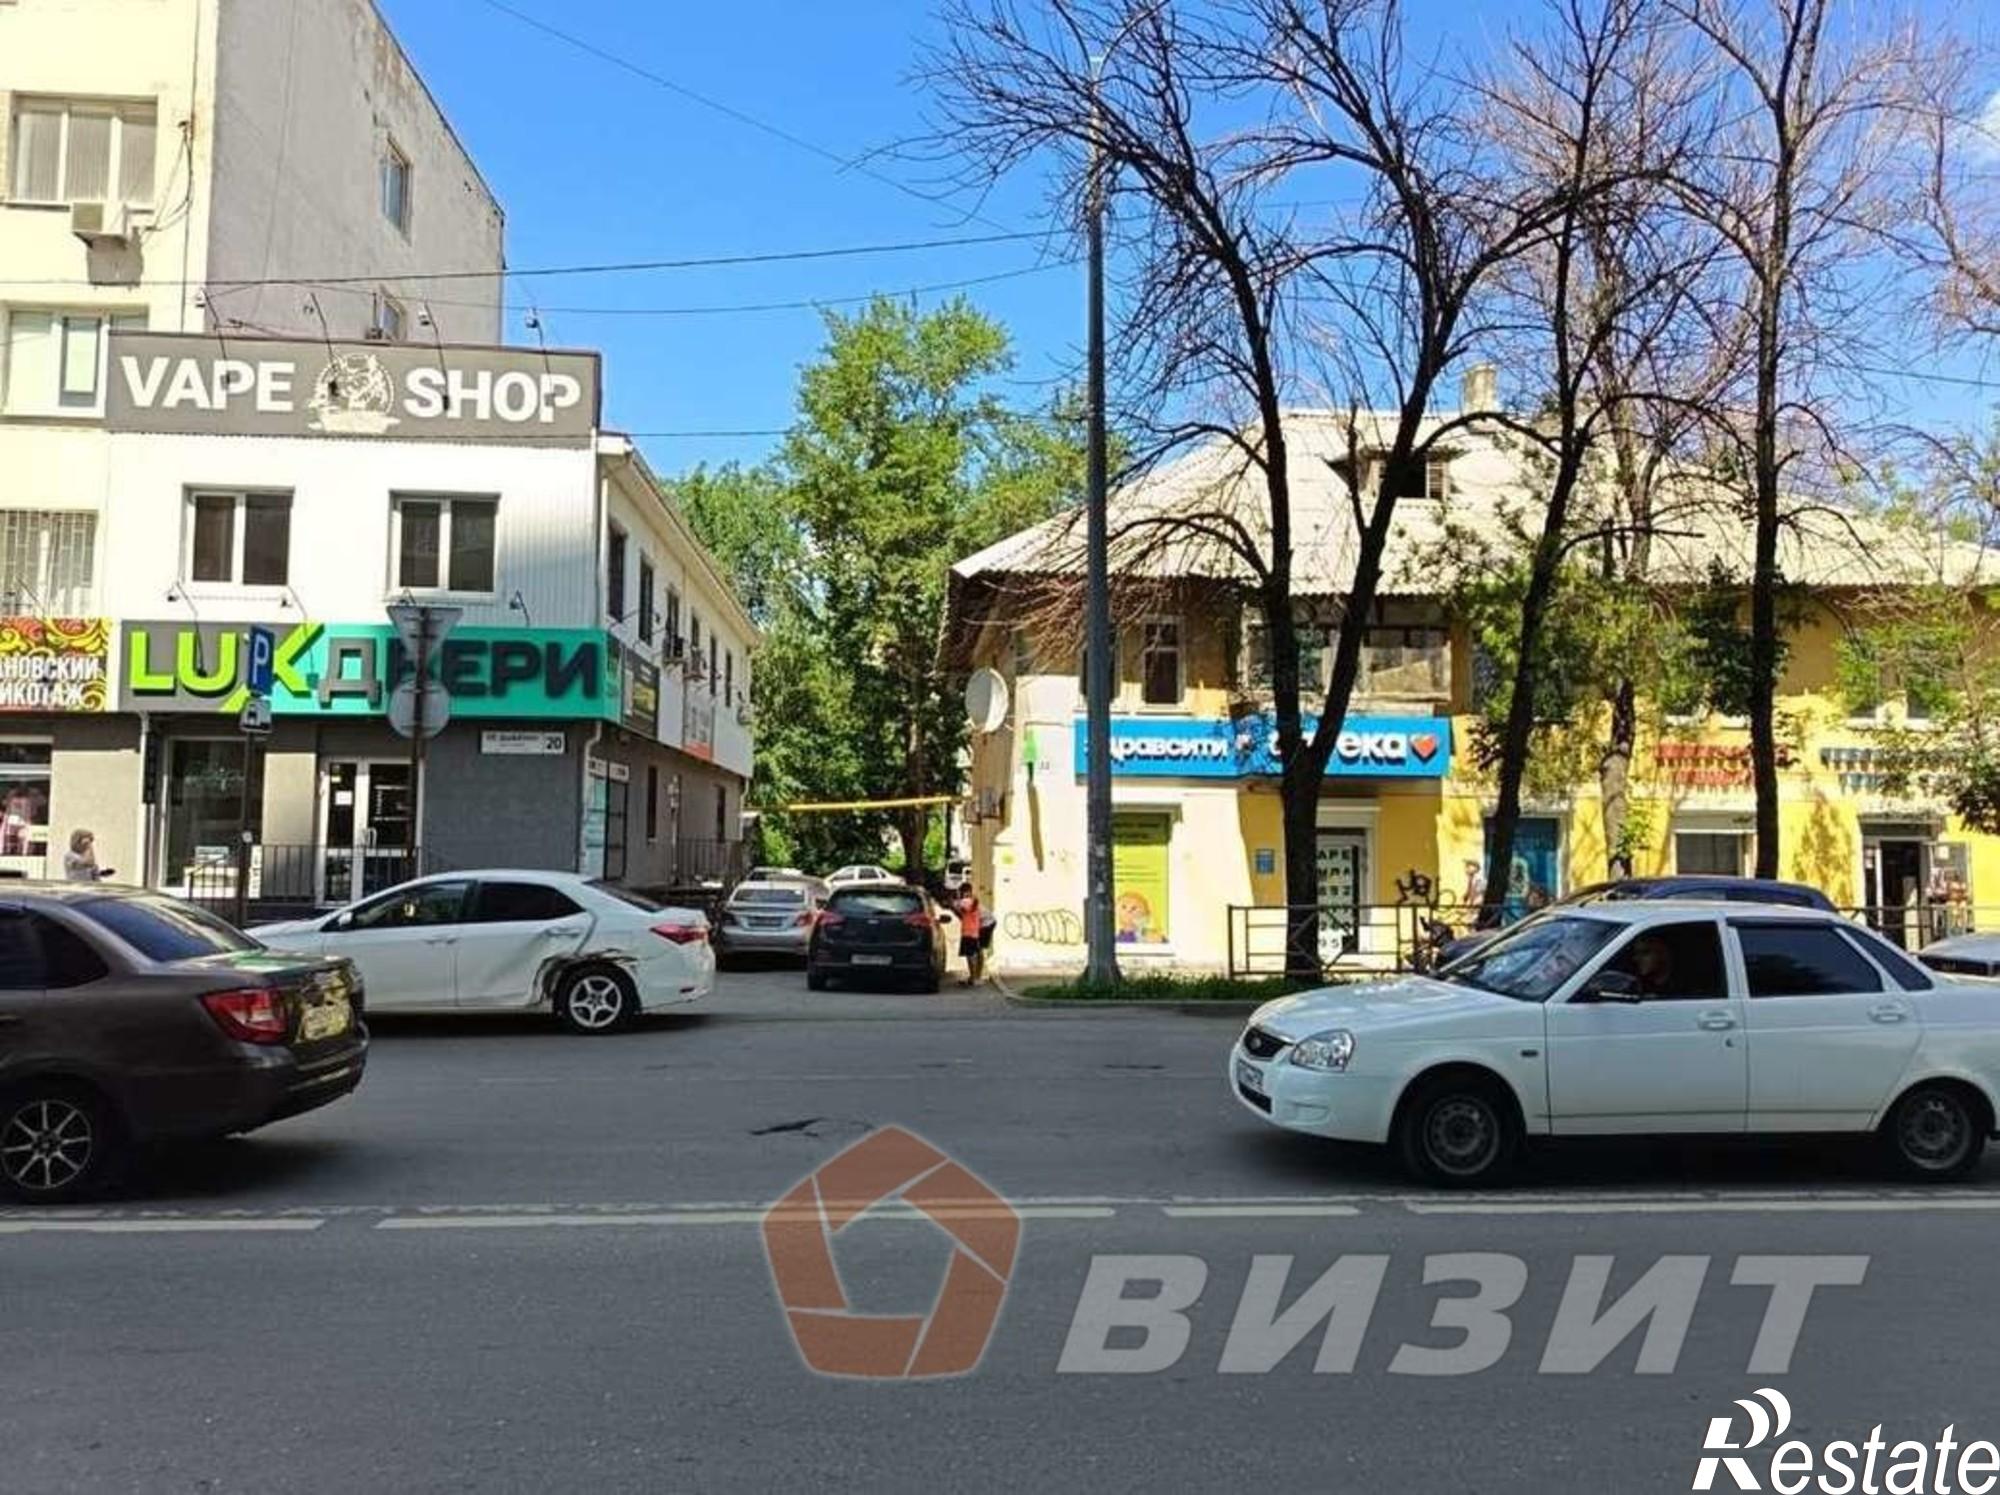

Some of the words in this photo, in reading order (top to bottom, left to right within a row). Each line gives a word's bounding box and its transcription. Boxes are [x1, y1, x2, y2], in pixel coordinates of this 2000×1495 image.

[120, 356, 295, 412] VAPE
[403, 367, 581, 424] SHOP
[546, 735, 562, 750] 20
[1084, 736, 1228, 761] дравсити
